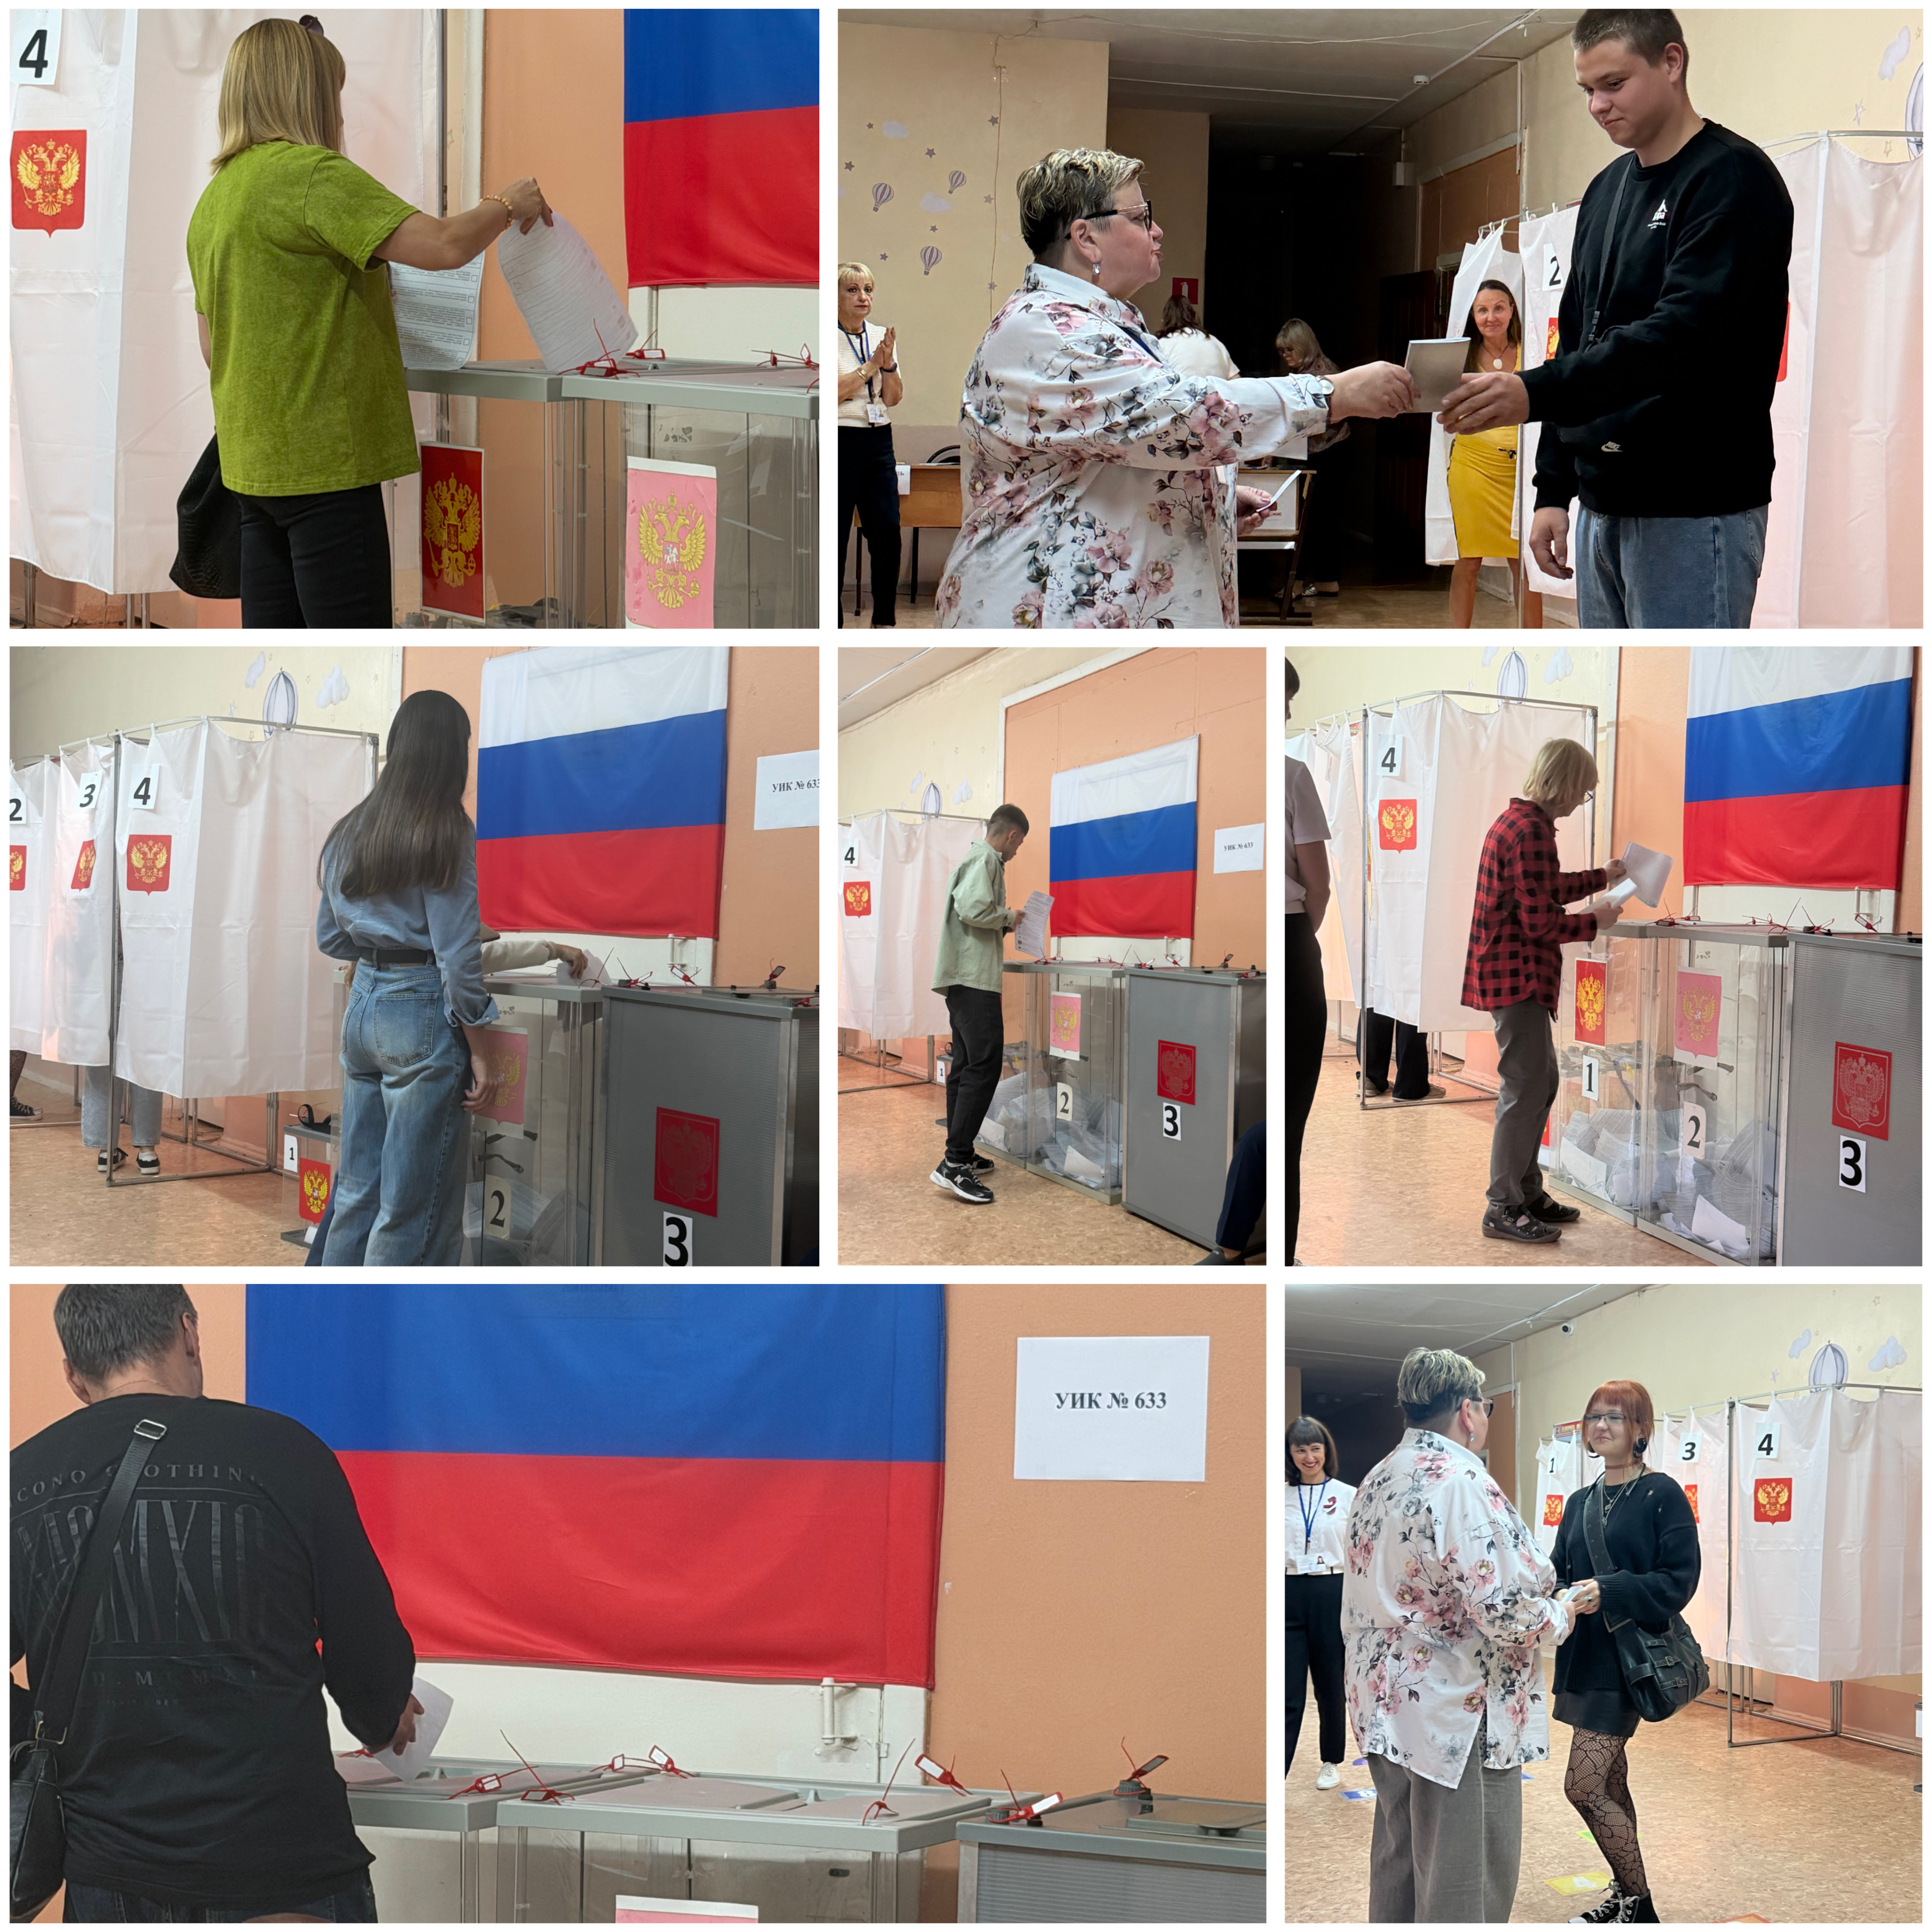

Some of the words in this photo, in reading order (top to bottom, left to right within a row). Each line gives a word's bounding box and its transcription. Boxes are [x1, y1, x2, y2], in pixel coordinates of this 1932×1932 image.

[19, 30, 48, 78] 4
[1549, 255, 1561, 286] 2
[1382, 747, 1396, 772] 4
[80, 784, 95, 807] 3
[133, 777, 151, 805] 4
[772, 782, 793, 793] УИК
[794, 781, 805, 790] №
[9, 798, 22, 821] 2
[844, 847, 855, 864] 4
[940, 1068, 944, 1076] 1
[1587, 1062, 1593, 1092] 1
[1060, 1091, 1069, 1114] 2
[1164, 1105, 1179, 1137] 3
[1687, 1115, 1701, 1148] 2
[289, 1147, 294, 1161] 1
[1841, 1139, 1863, 1186] 3
[489, 1190, 505, 1228] 2
[664, 1216, 688, 1266] 3
[1055, 1393, 1102, 1409] УИК
[1106, 1392, 1129, 1409] №
[1134, 1392, 1167, 1409] 633
[1682, 1442, 1696, 1461] 3
[1757, 1433, 1774, 1456] 4
[1549, 1457, 1554, 1473] 1
